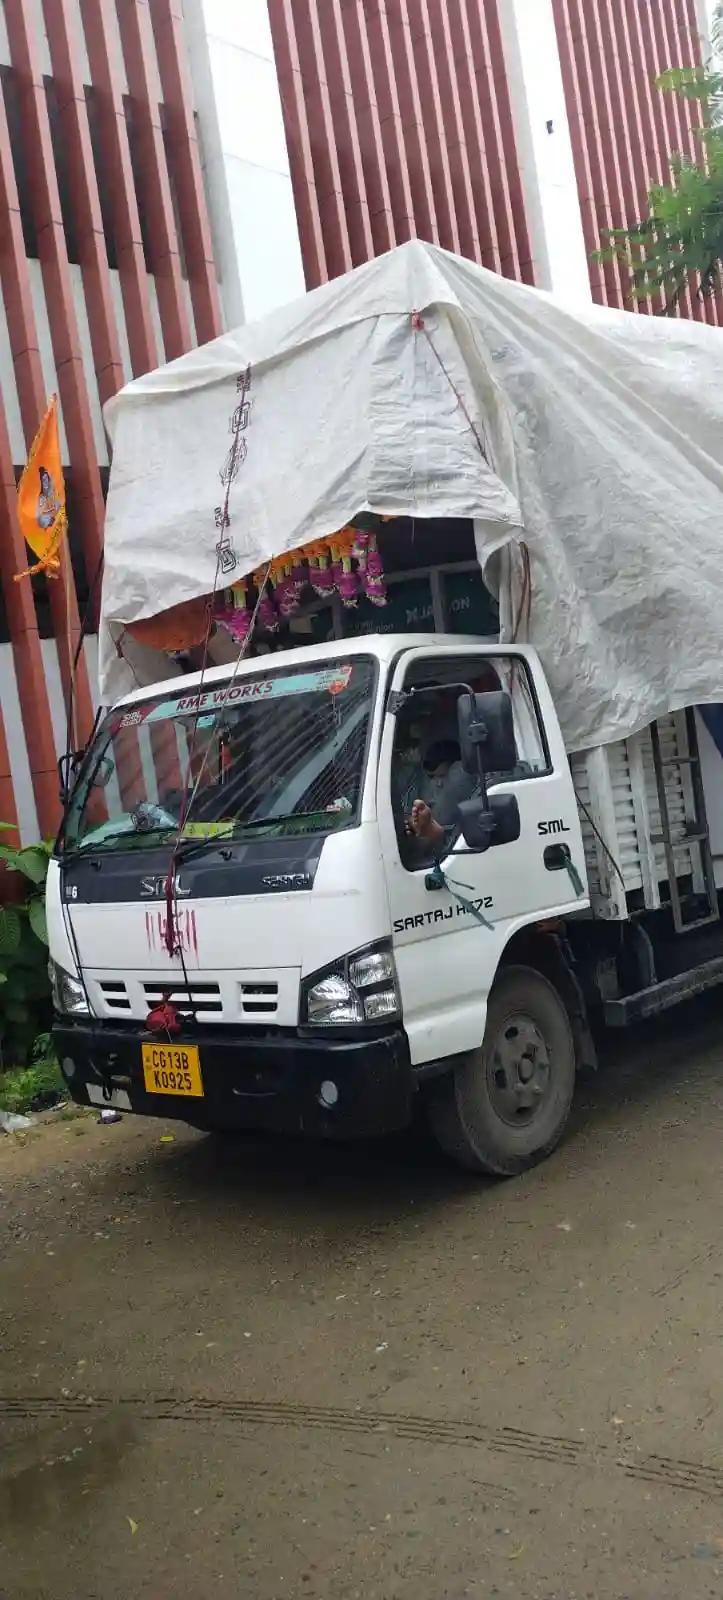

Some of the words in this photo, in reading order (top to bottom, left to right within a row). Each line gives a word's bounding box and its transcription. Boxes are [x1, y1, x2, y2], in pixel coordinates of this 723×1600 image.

[420, 596, 470, 619] JAON
[213, 680, 274, 704] WORKS
[538, 819, 570, 835] SML
[393, 906, 453, 933] SARTAJ
[152, 1050, 189, 1070] CG13B
[153, 1070, 192, 1090] K0925
